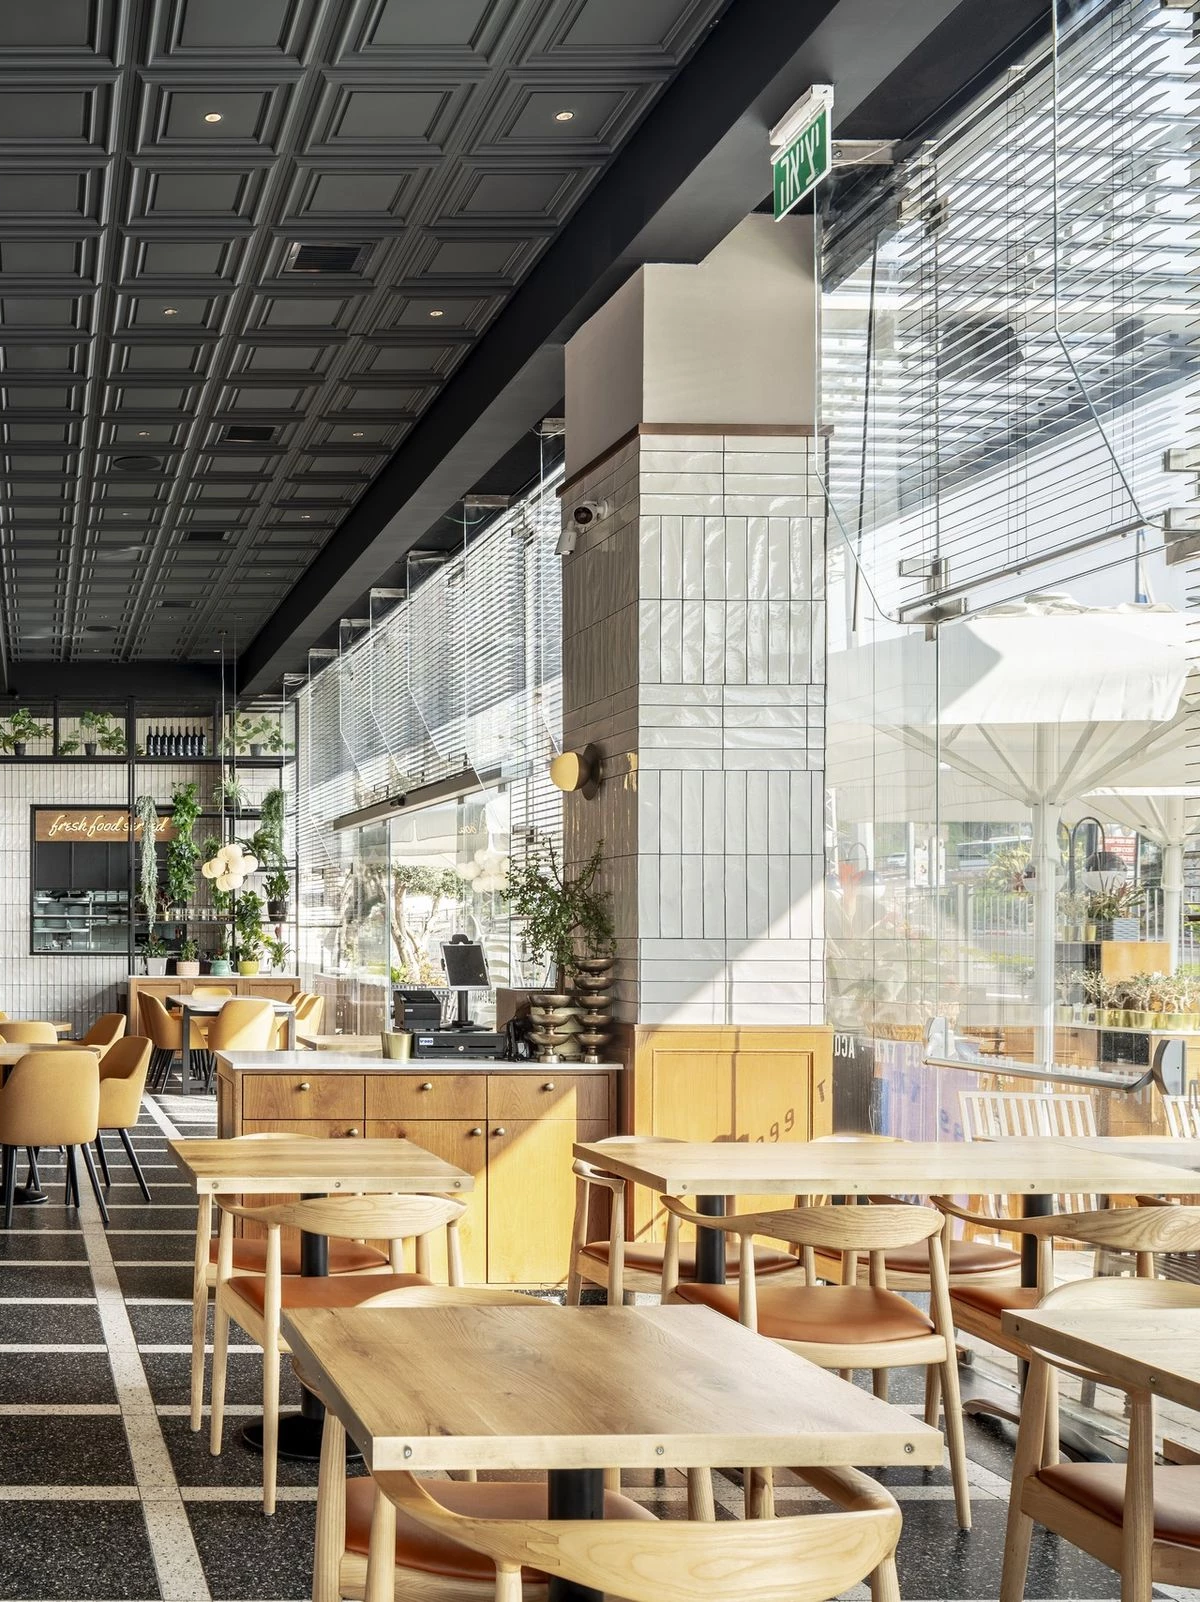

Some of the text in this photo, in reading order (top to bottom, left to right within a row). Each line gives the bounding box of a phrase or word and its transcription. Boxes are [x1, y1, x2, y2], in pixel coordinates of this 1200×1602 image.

[780, 121, 820, 212] יציאה
[48, 814, 87, 837] fresh
[87, 814, 124, 837] food
